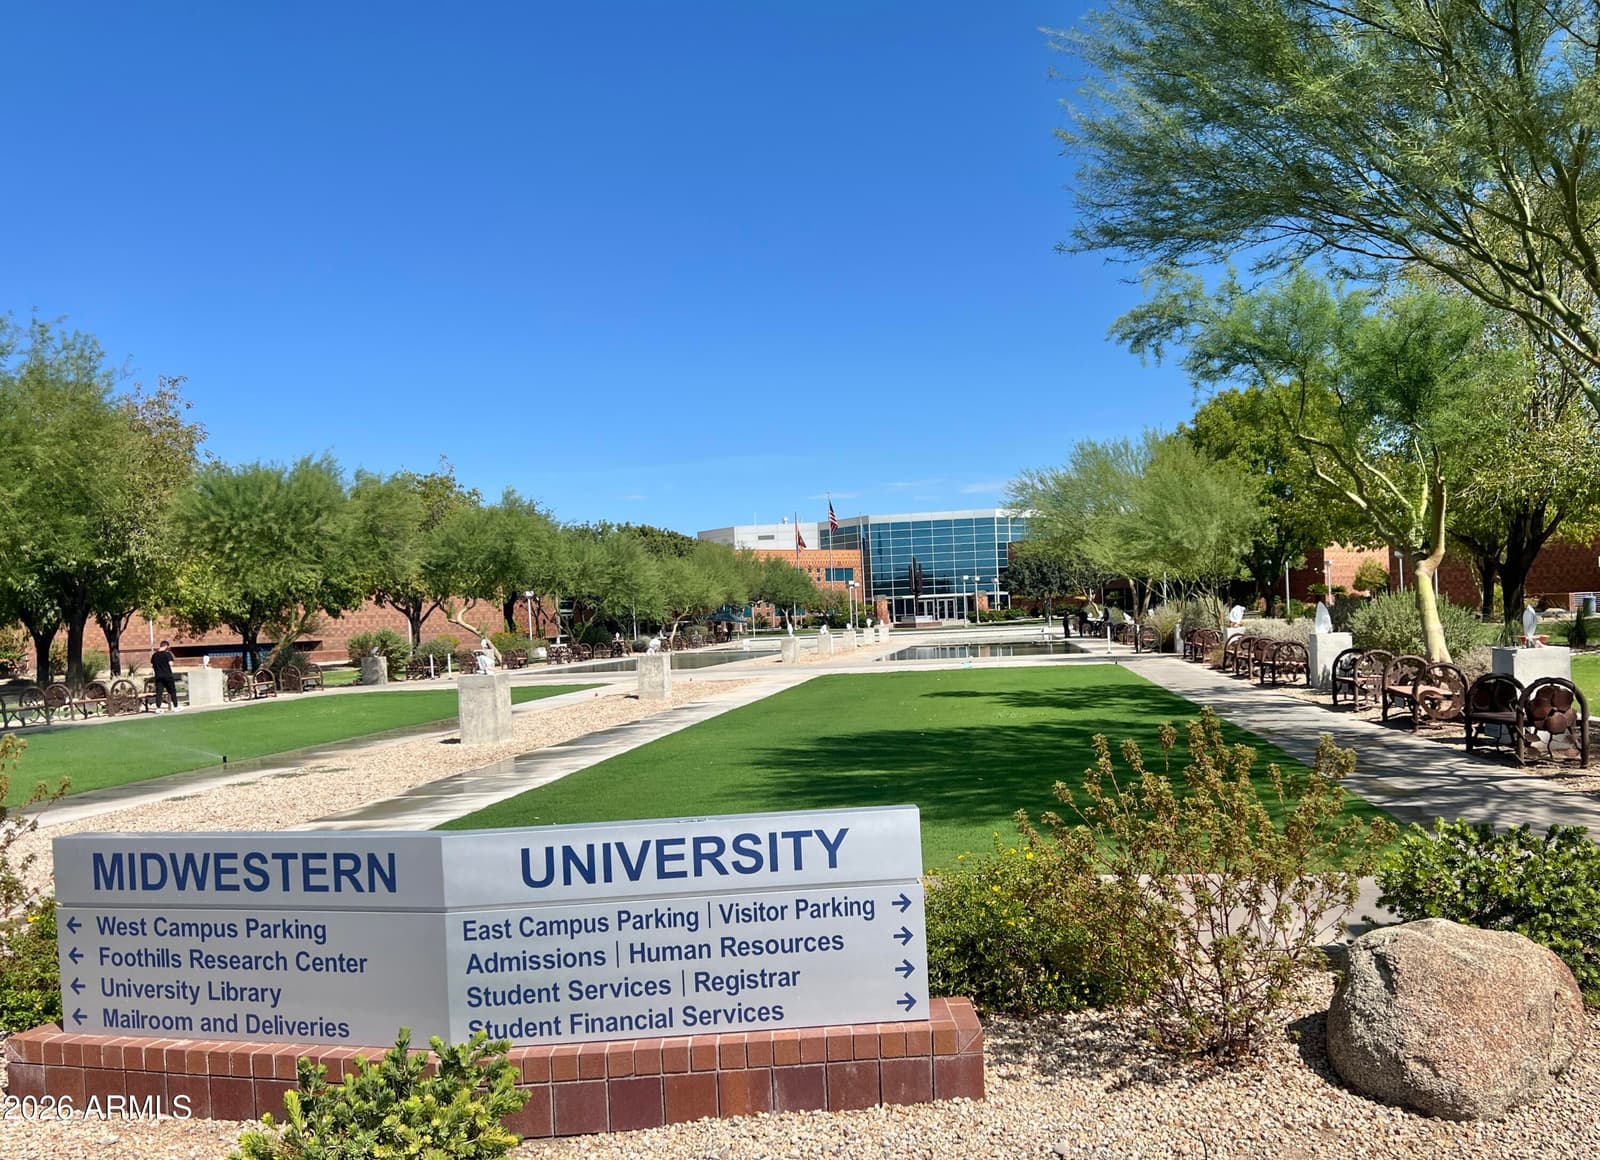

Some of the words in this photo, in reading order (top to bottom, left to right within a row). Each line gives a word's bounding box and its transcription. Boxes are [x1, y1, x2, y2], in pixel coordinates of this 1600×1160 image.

[91, 851, 397, 894] MIDWESTERN
[520, 828, 849, 889] UNIVERSITY
[95, 915, 148, 937] West
[153, 916, 239, 943] Campus
[245, 917, 327, 946] Parking
[462, 918, 513, 942] East
[518, 916, 610, 940] Campus
[617, 907, 699, 933] Parking
[718, 901, 789, 925] Visitor
[795, 895, 875, 921] Parking
[98, 946, 183, 969] Foothills
[189, 948, 288, 972] Research
[295, 950, 369, 974] Center
[465, 947, 607, 975] Admissions
[629, 942, 712, 964] Human
[720, 934, 845, 958] Resources
[100, 976, 200, 1005] University
[207, 980, 282, 1009] Library
[466, 982, 561, 1008] Student
[568, 976, 672, 1002] Services
[694, 968, 801, 996] Registrar
[102, 1007, 193, 1031] Mailroom
[200, 1014, 238, 1033] and
[245, 1013, 350, 1038] Deliveries
[468, 1015, 562, 1041] Student
[569, 1006, 674, 1035] Financial
[682, 1002, 784, 1027] Services
